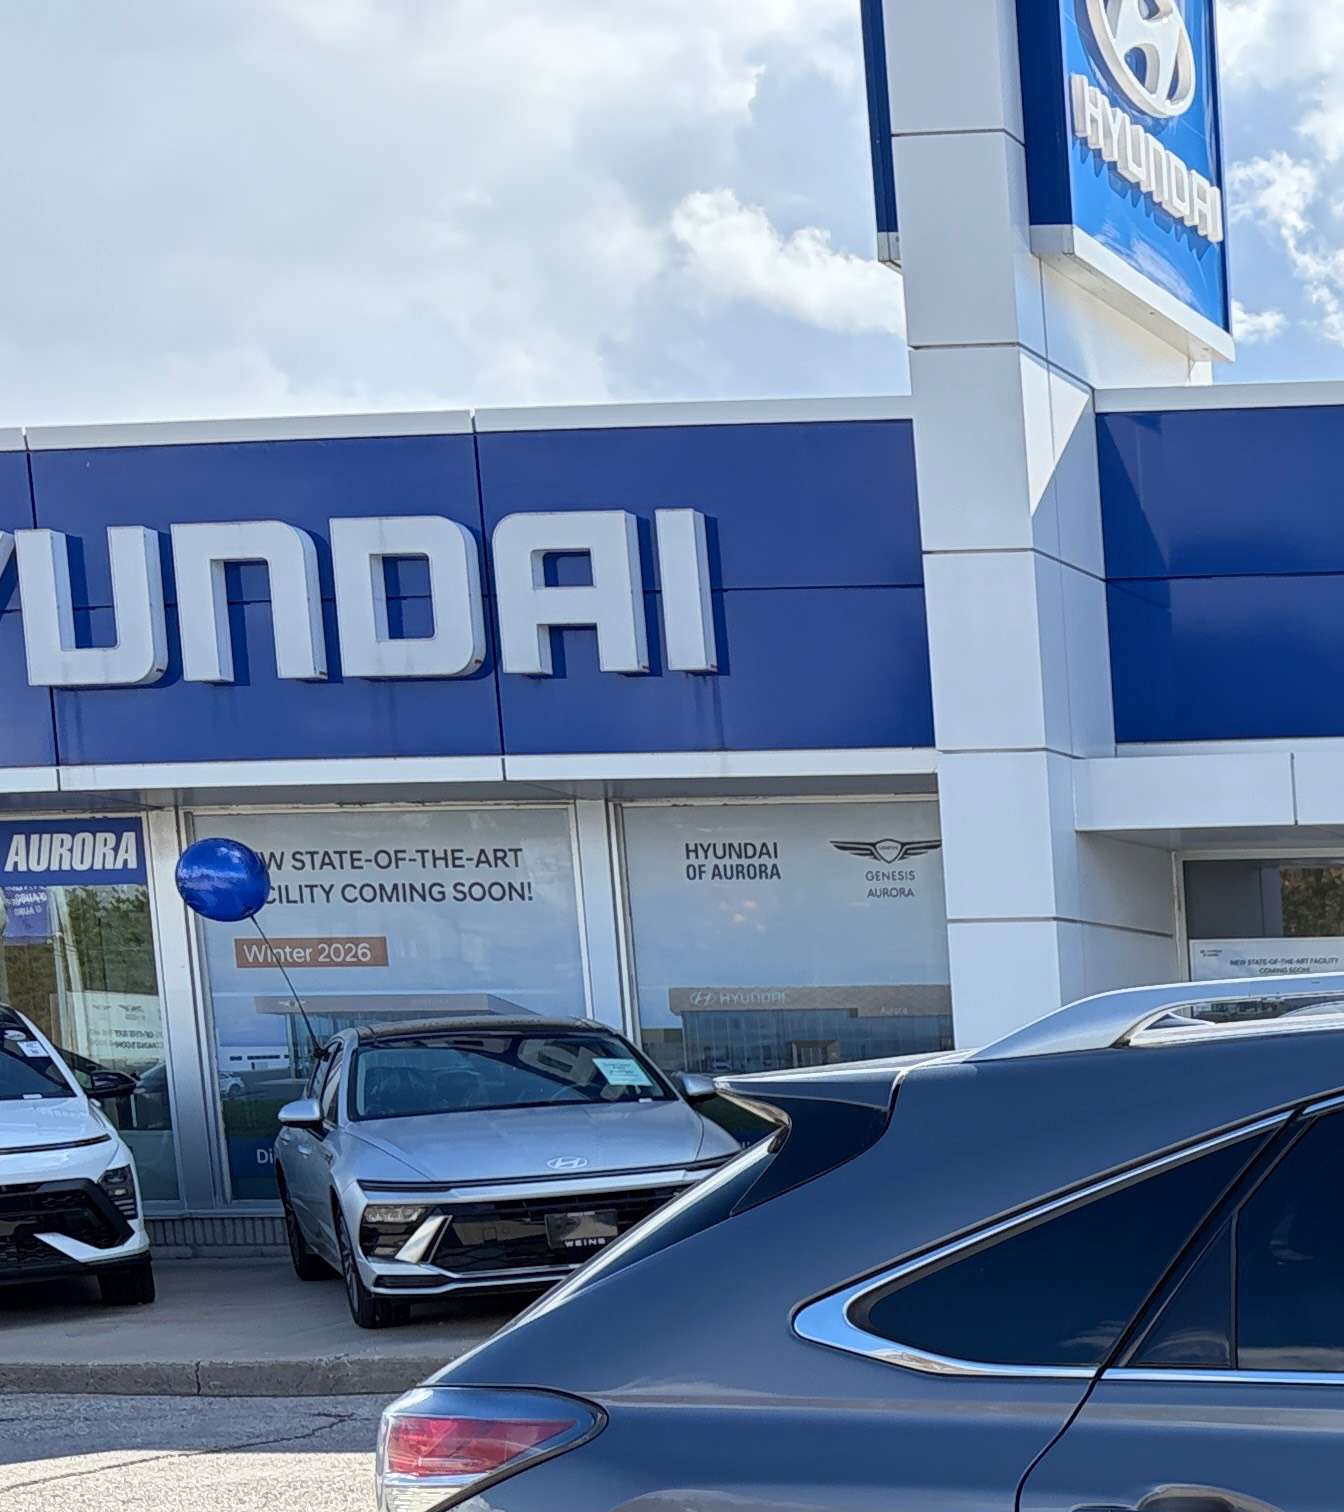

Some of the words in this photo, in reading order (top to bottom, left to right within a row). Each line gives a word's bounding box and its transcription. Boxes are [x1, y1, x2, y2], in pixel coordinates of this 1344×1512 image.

[1070, 73, 1223, 243] HYUNDAI
[0, 508, 719, 688] UNDAI
[4, 831, 138, 872] AURORA
[291, 848, 523, 871] STATE-OF-THE-ART
[685, 841, 779, 860] HYUNDAI
[686, 864, 706, 880] OF
[711, 863, 781, 880] AURORA
[865, 870, 916, 882] GENESIS
[340, 882, 446, 903] COMING
[452, 881, 534, 902] SOON!
[867, 887, 914, 898] AURORA
[243, 943, 313, 963] Winter
[317, 942, 372, 963] 2026
